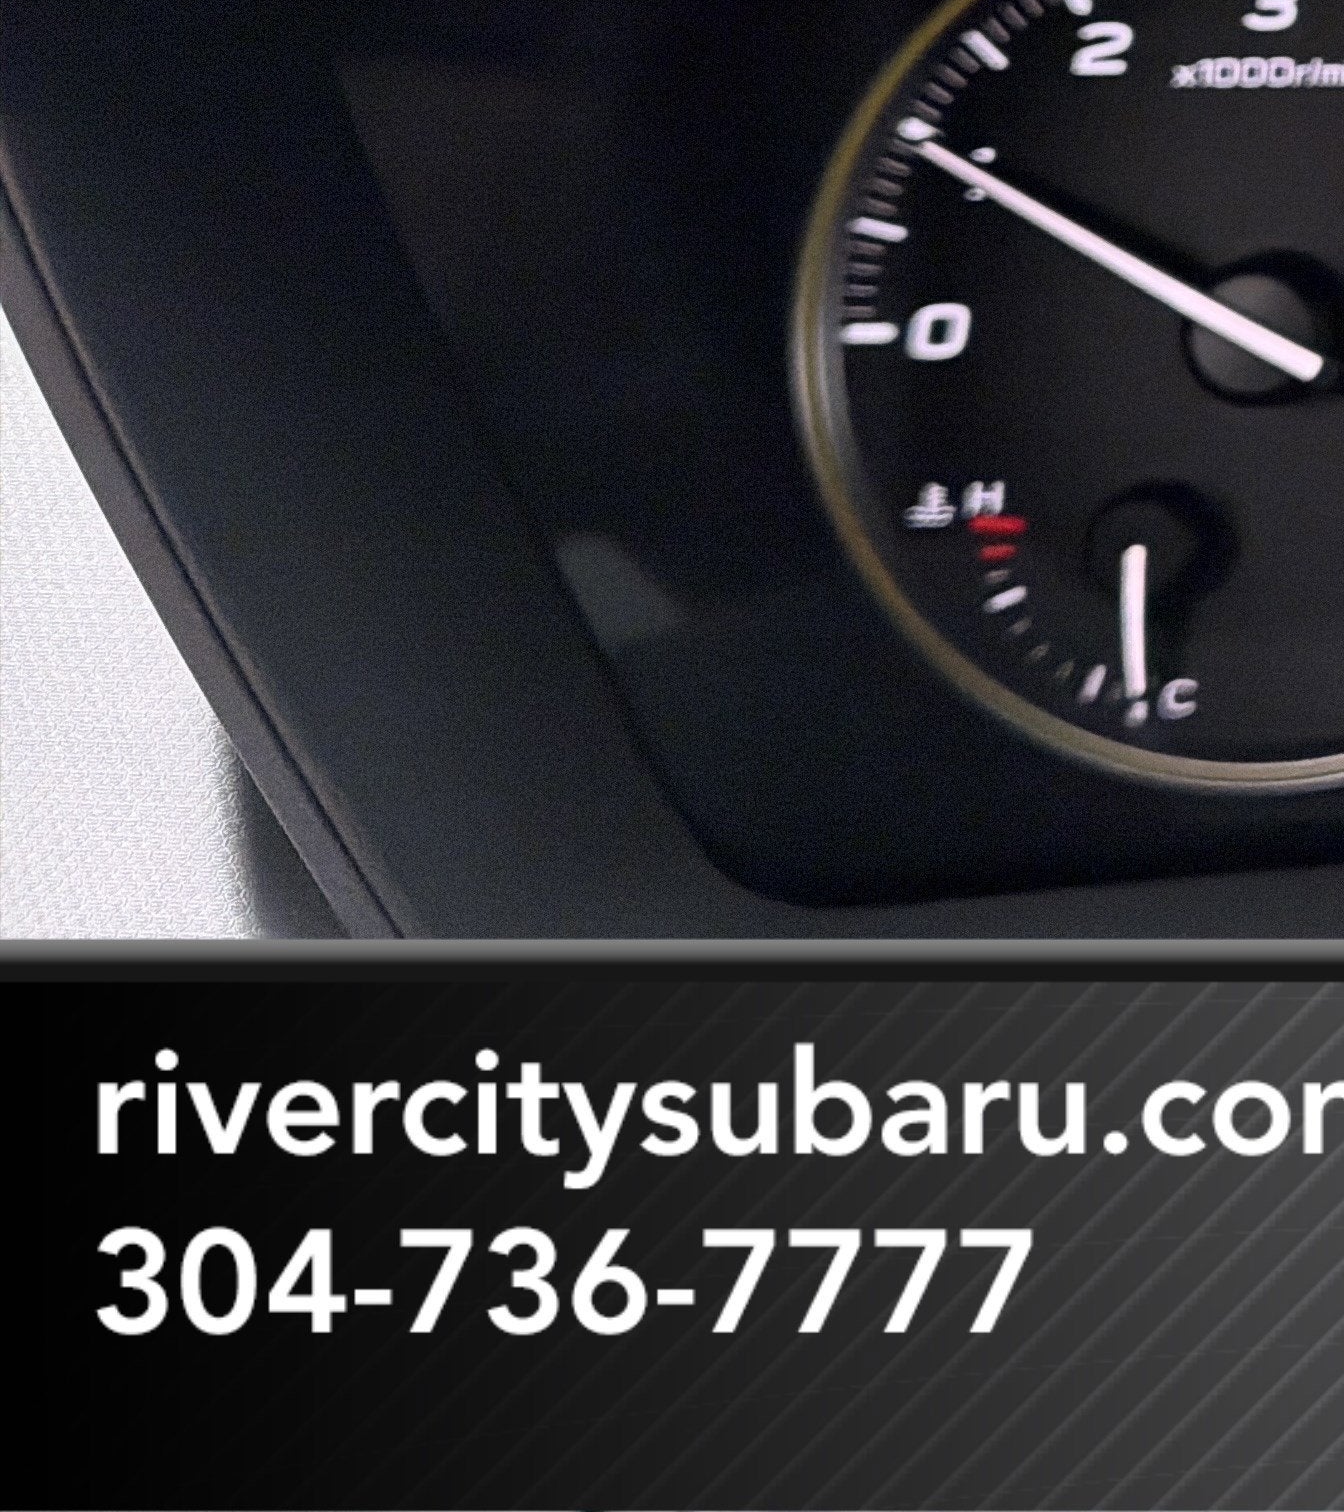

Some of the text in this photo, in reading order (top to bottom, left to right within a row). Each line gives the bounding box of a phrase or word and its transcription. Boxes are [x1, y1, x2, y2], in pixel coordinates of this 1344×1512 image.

[1070, 21, 1134, 76] 2
[906, 302, 972, 361] 0
[963, 481, 1004, 513] H
[1158, 677, 1199, 720] C
